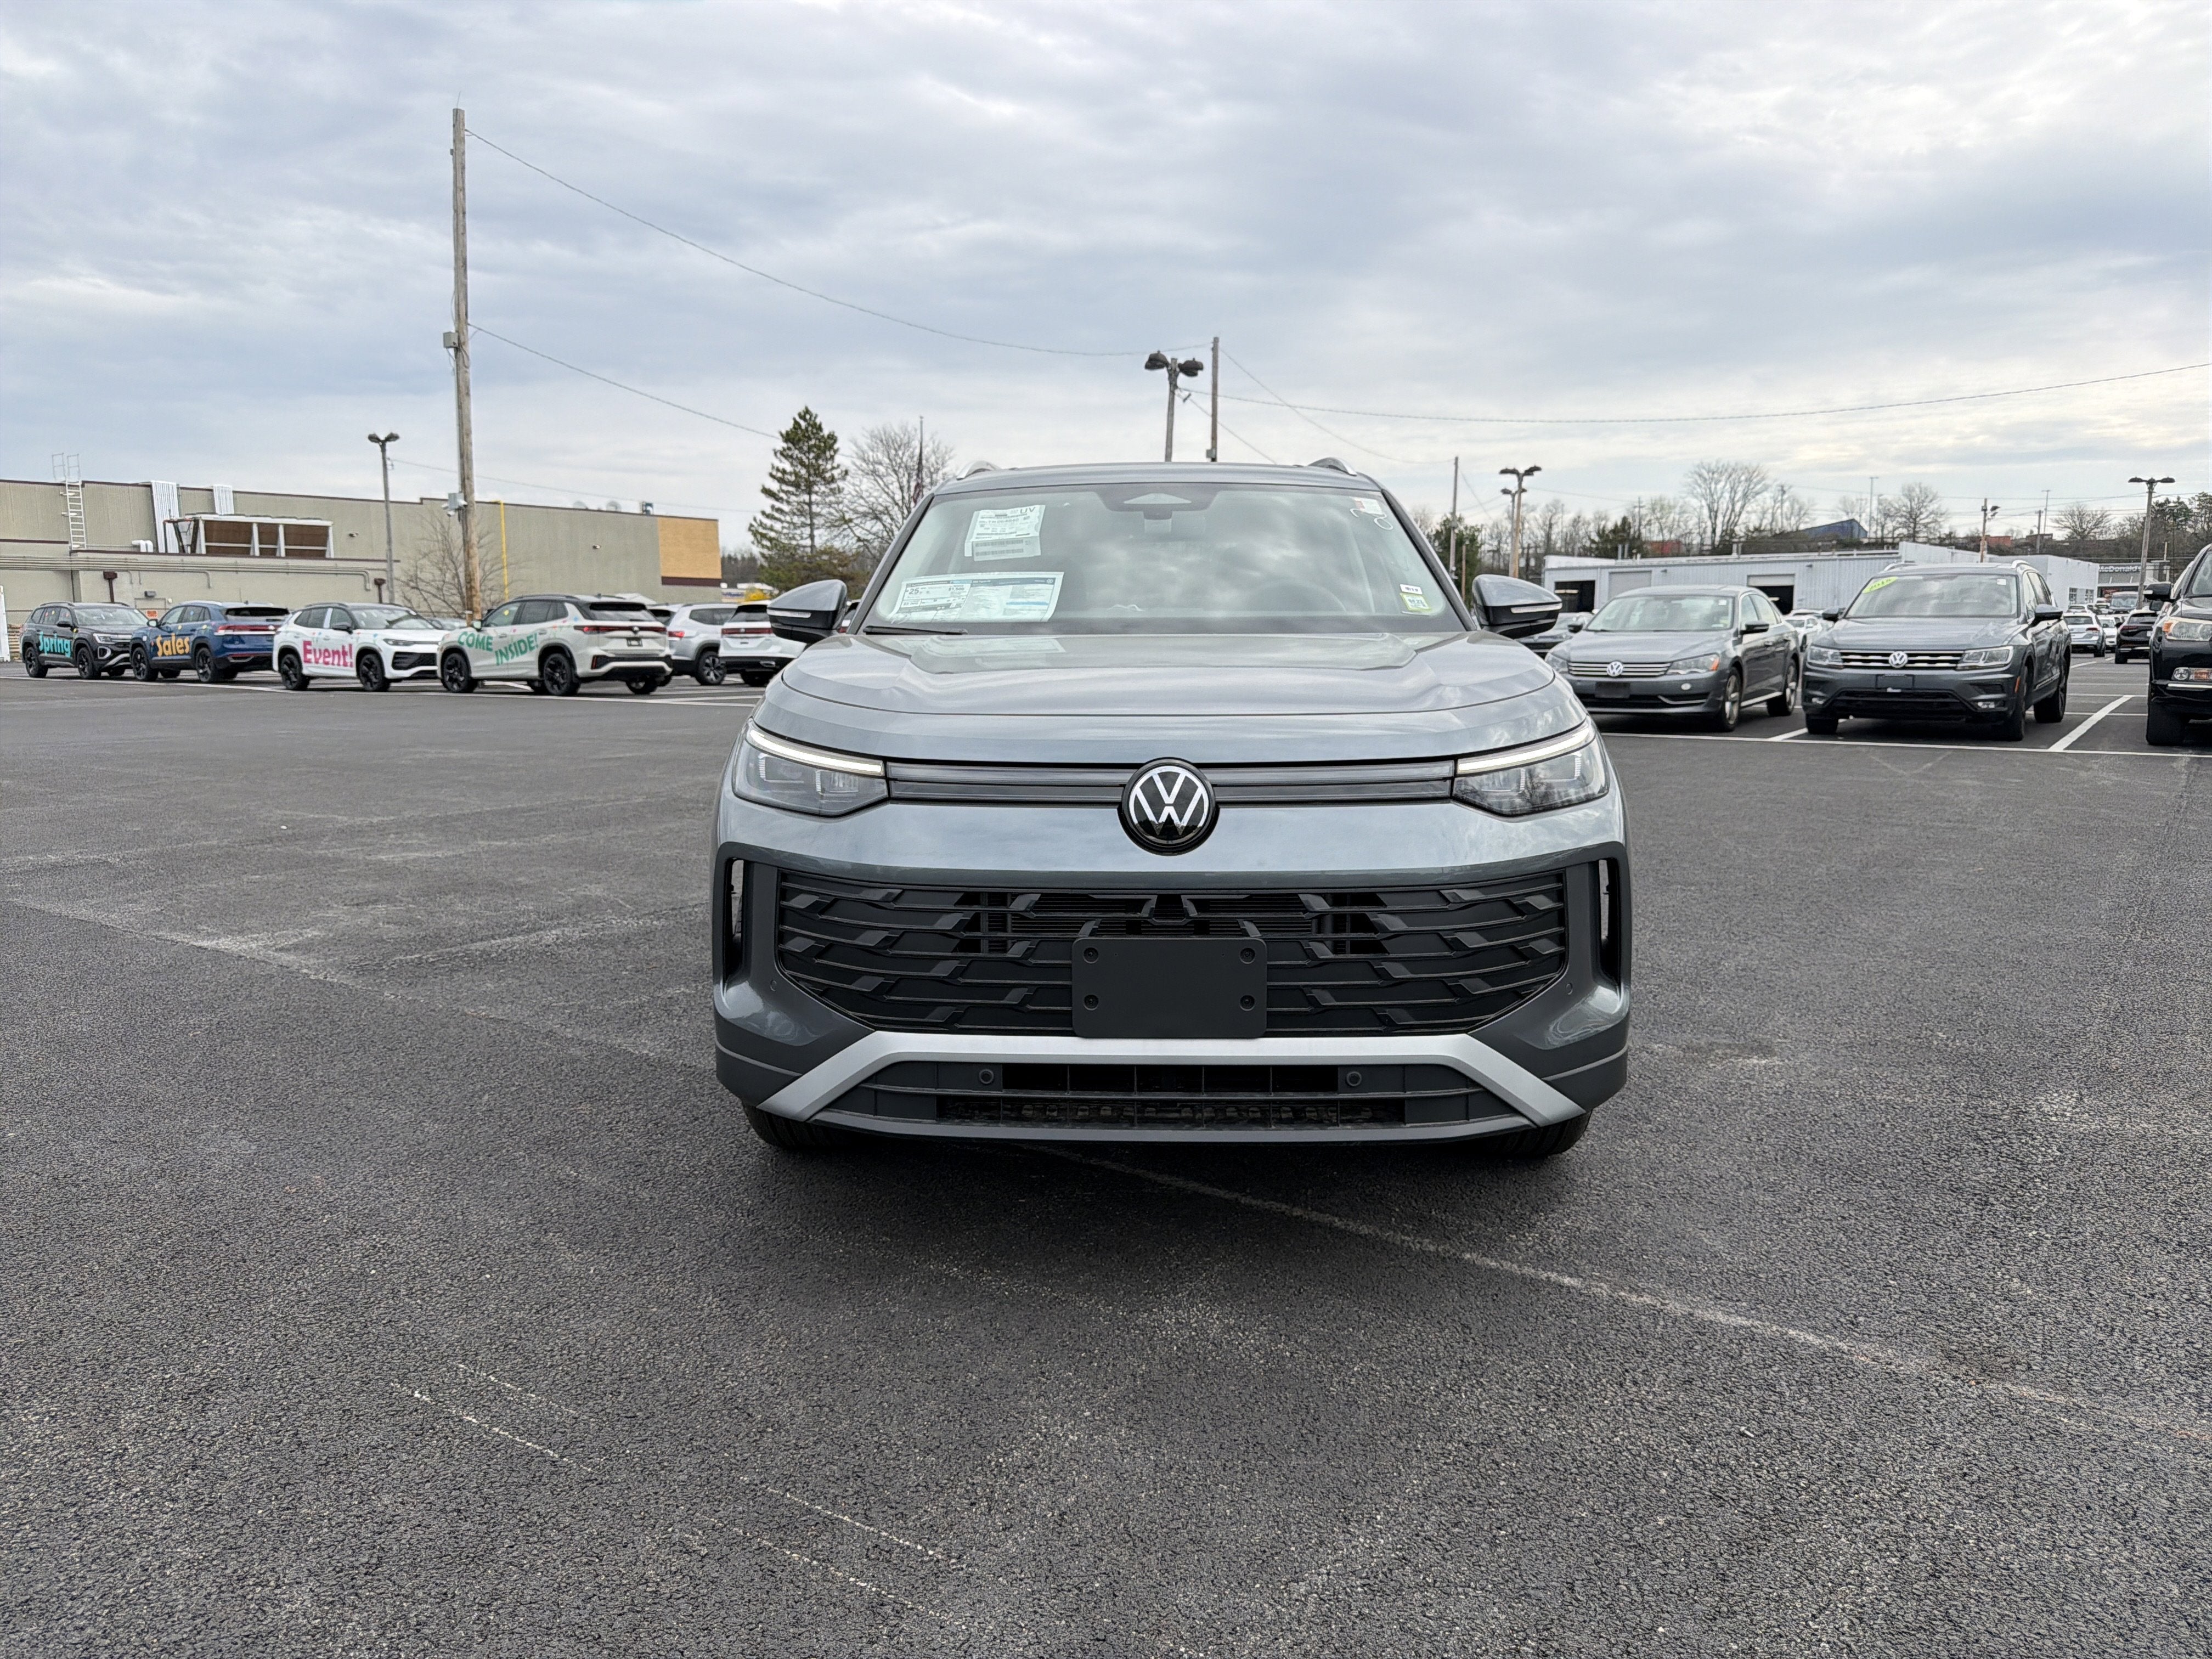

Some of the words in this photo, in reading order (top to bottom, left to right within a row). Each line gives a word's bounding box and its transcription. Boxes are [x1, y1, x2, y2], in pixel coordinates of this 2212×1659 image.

[39, 631, 71, 658] Spring
[156, 633, 190, 657] Sales
[303, 640, 353, 668] Event!
[458, 631, 493, 652] COME
[495, 632, 539, 665] INSIDE!
